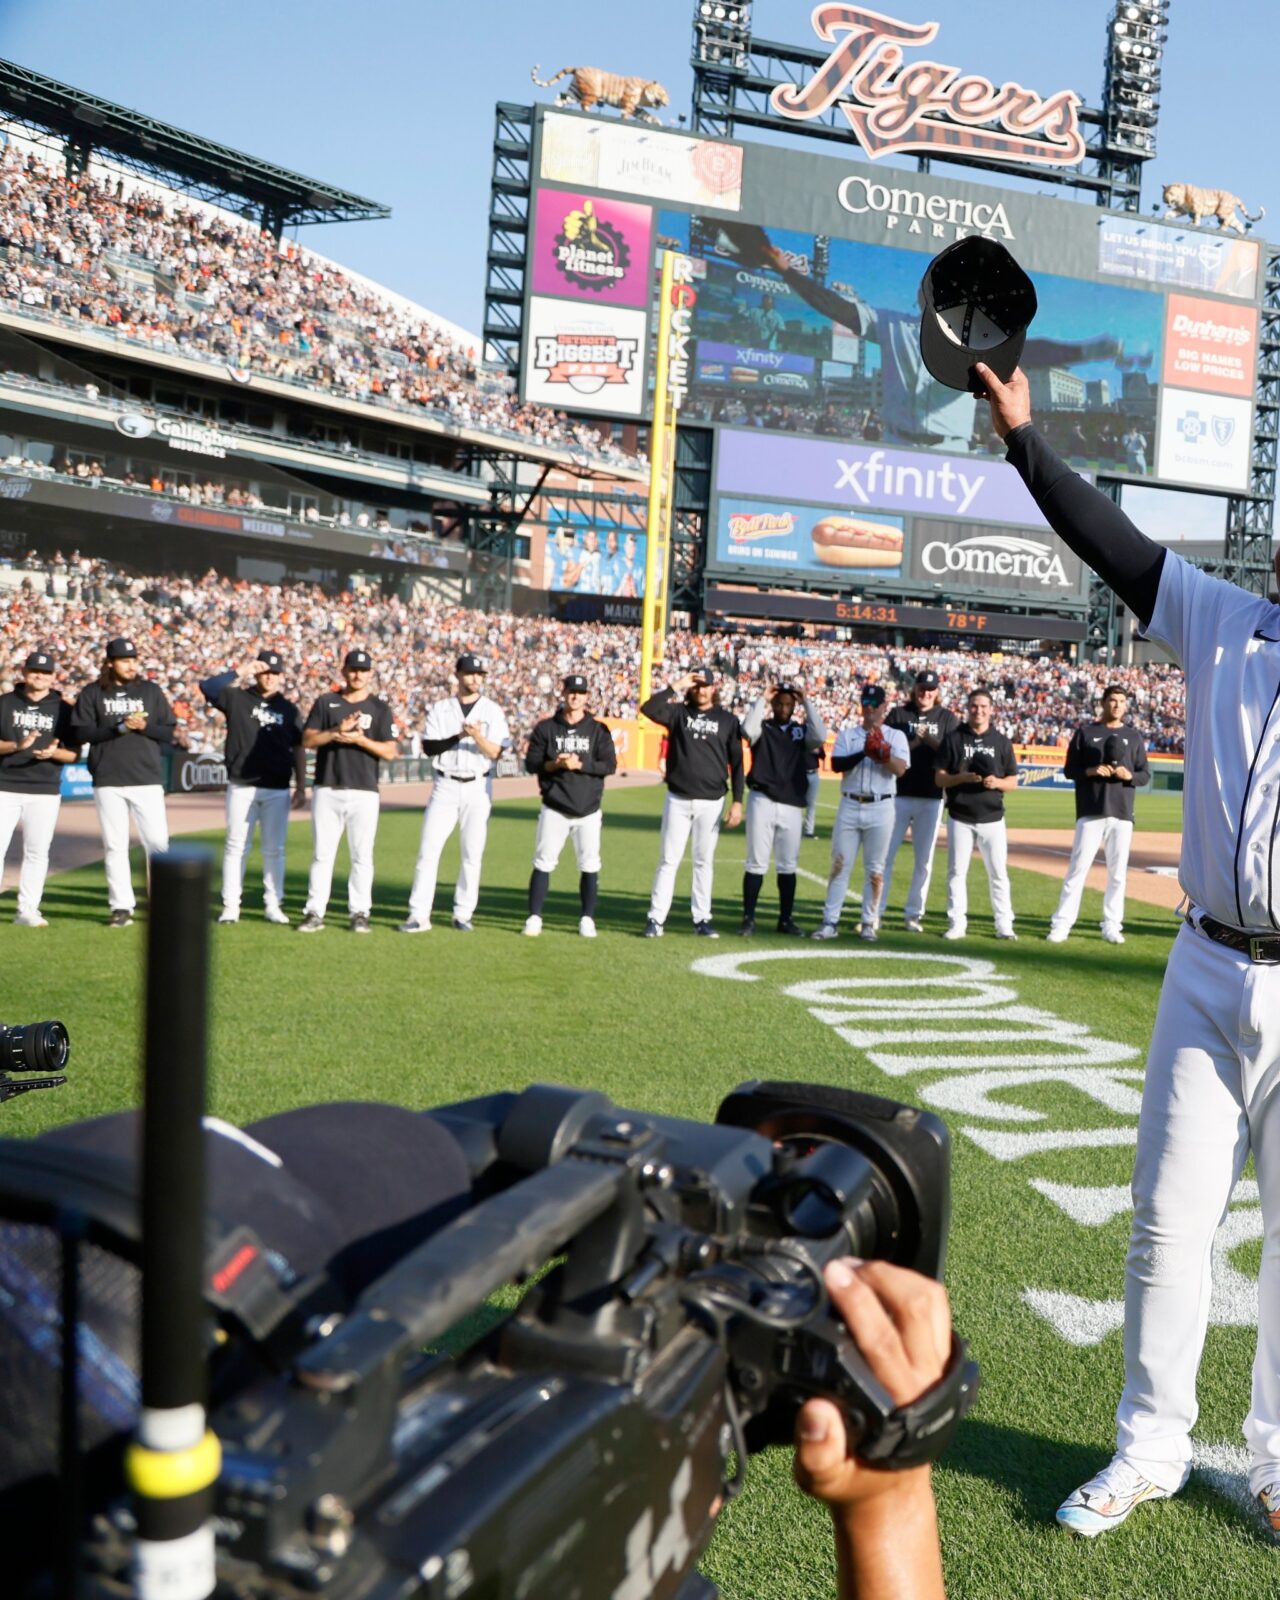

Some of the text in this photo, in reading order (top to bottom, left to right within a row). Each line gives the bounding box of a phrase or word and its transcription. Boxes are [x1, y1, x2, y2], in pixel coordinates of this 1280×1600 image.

[770, 2, 1085, 160] Tigers
[887, 215, 974, 241] PARK
[558, 244, 614, 264] planet
[1103, 232, 1123, 243] LET
[1124, 235, 1140, 246] US
[1175, 244, 1197, 257] YOU
[565, 259, 624, 278] fitness
[557, 335, 616, 345] DETROIT'S
[667, 258, 697, 409] ROCKET
[536, 337, 638, 369] BIGGEST
[736, 348, 784, 367] xfinity
[1178, 348, 1243, 368] BIG NAMES
[567, 364, 608, 373] FAN
[1173, 360, 1245, 381] LOW PRICES
[156, 418, 237, 449] Gallagher
[168, 438, 226, 458] INSURANCE
[833, 451, 986, 514] xfinity
[764, 548, 798, 561] SUMMER
[836, 602, 987, 630] 5:14:31 78°F
[104, 697, 145, 714] TIGERS
[13, 711, 54, 729] TIGERS
[181, 760, 230, 791] Comeri
